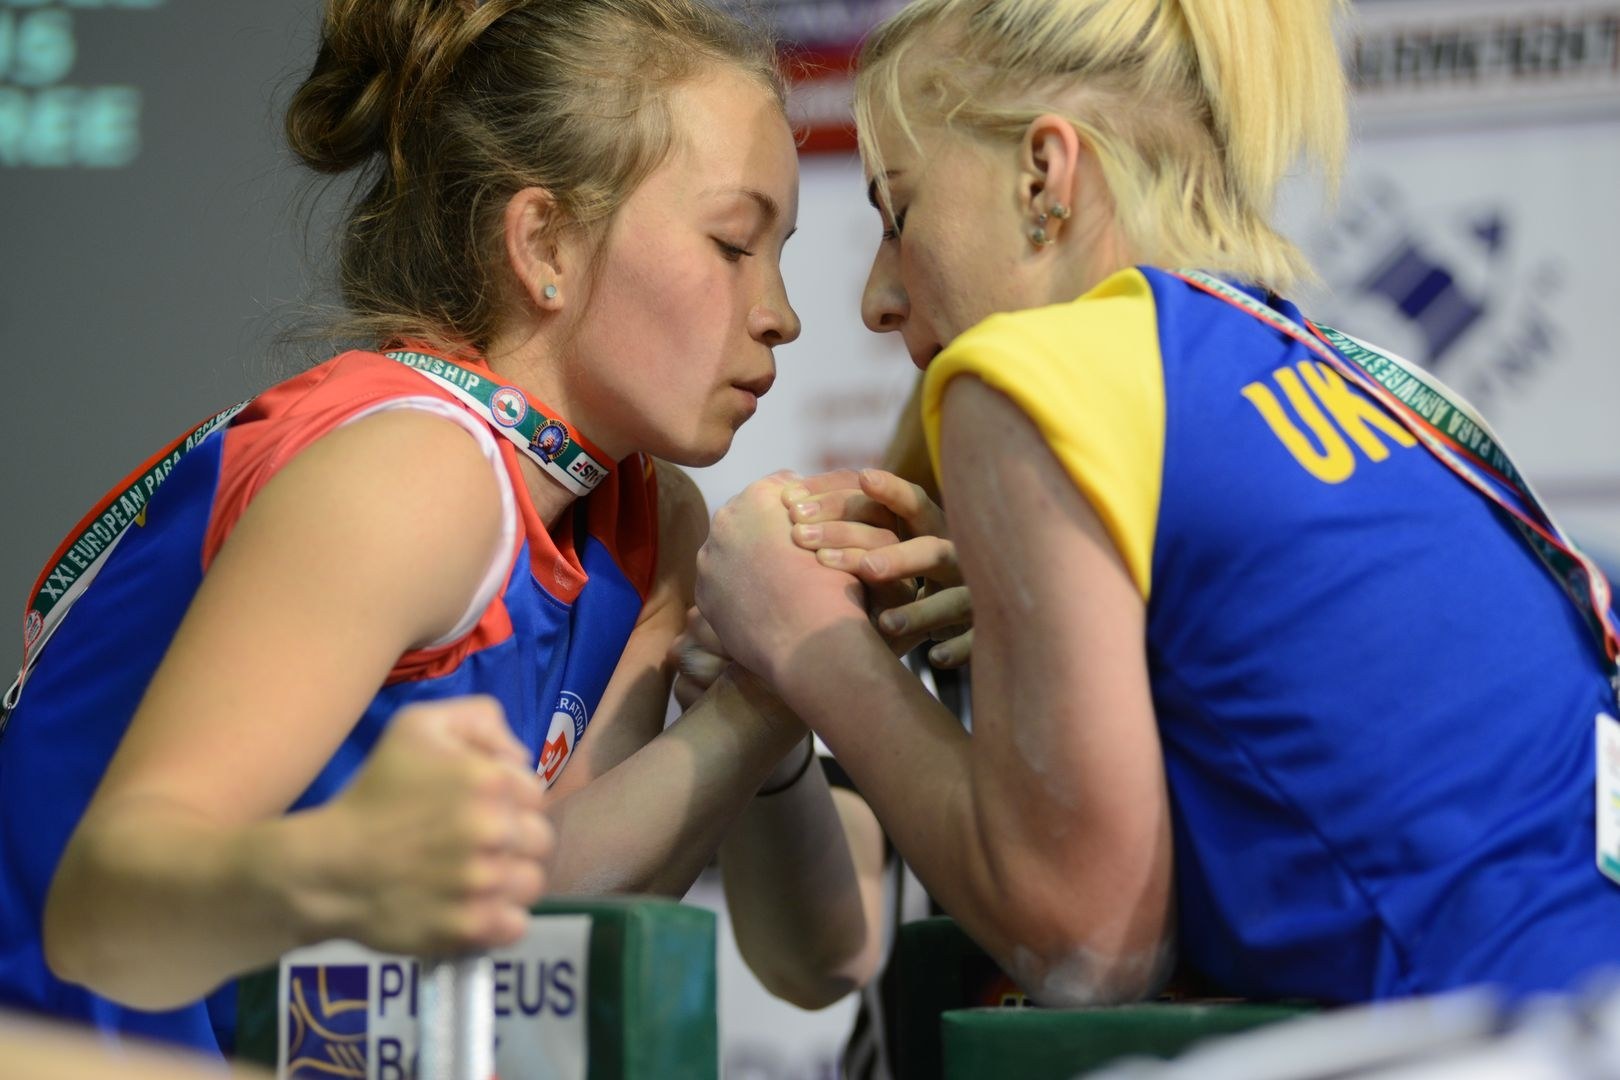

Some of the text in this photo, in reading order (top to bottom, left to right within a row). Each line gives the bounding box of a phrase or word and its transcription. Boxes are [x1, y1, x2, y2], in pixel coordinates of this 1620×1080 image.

[40, 564, 75, 600] XXI
[68, 485, 146, 569] EUROPEAN
[145, 450, 181, 495] PARA
[555, 697, 584, 736] RATION
[378, 960, 576, 1018] PIEUS
